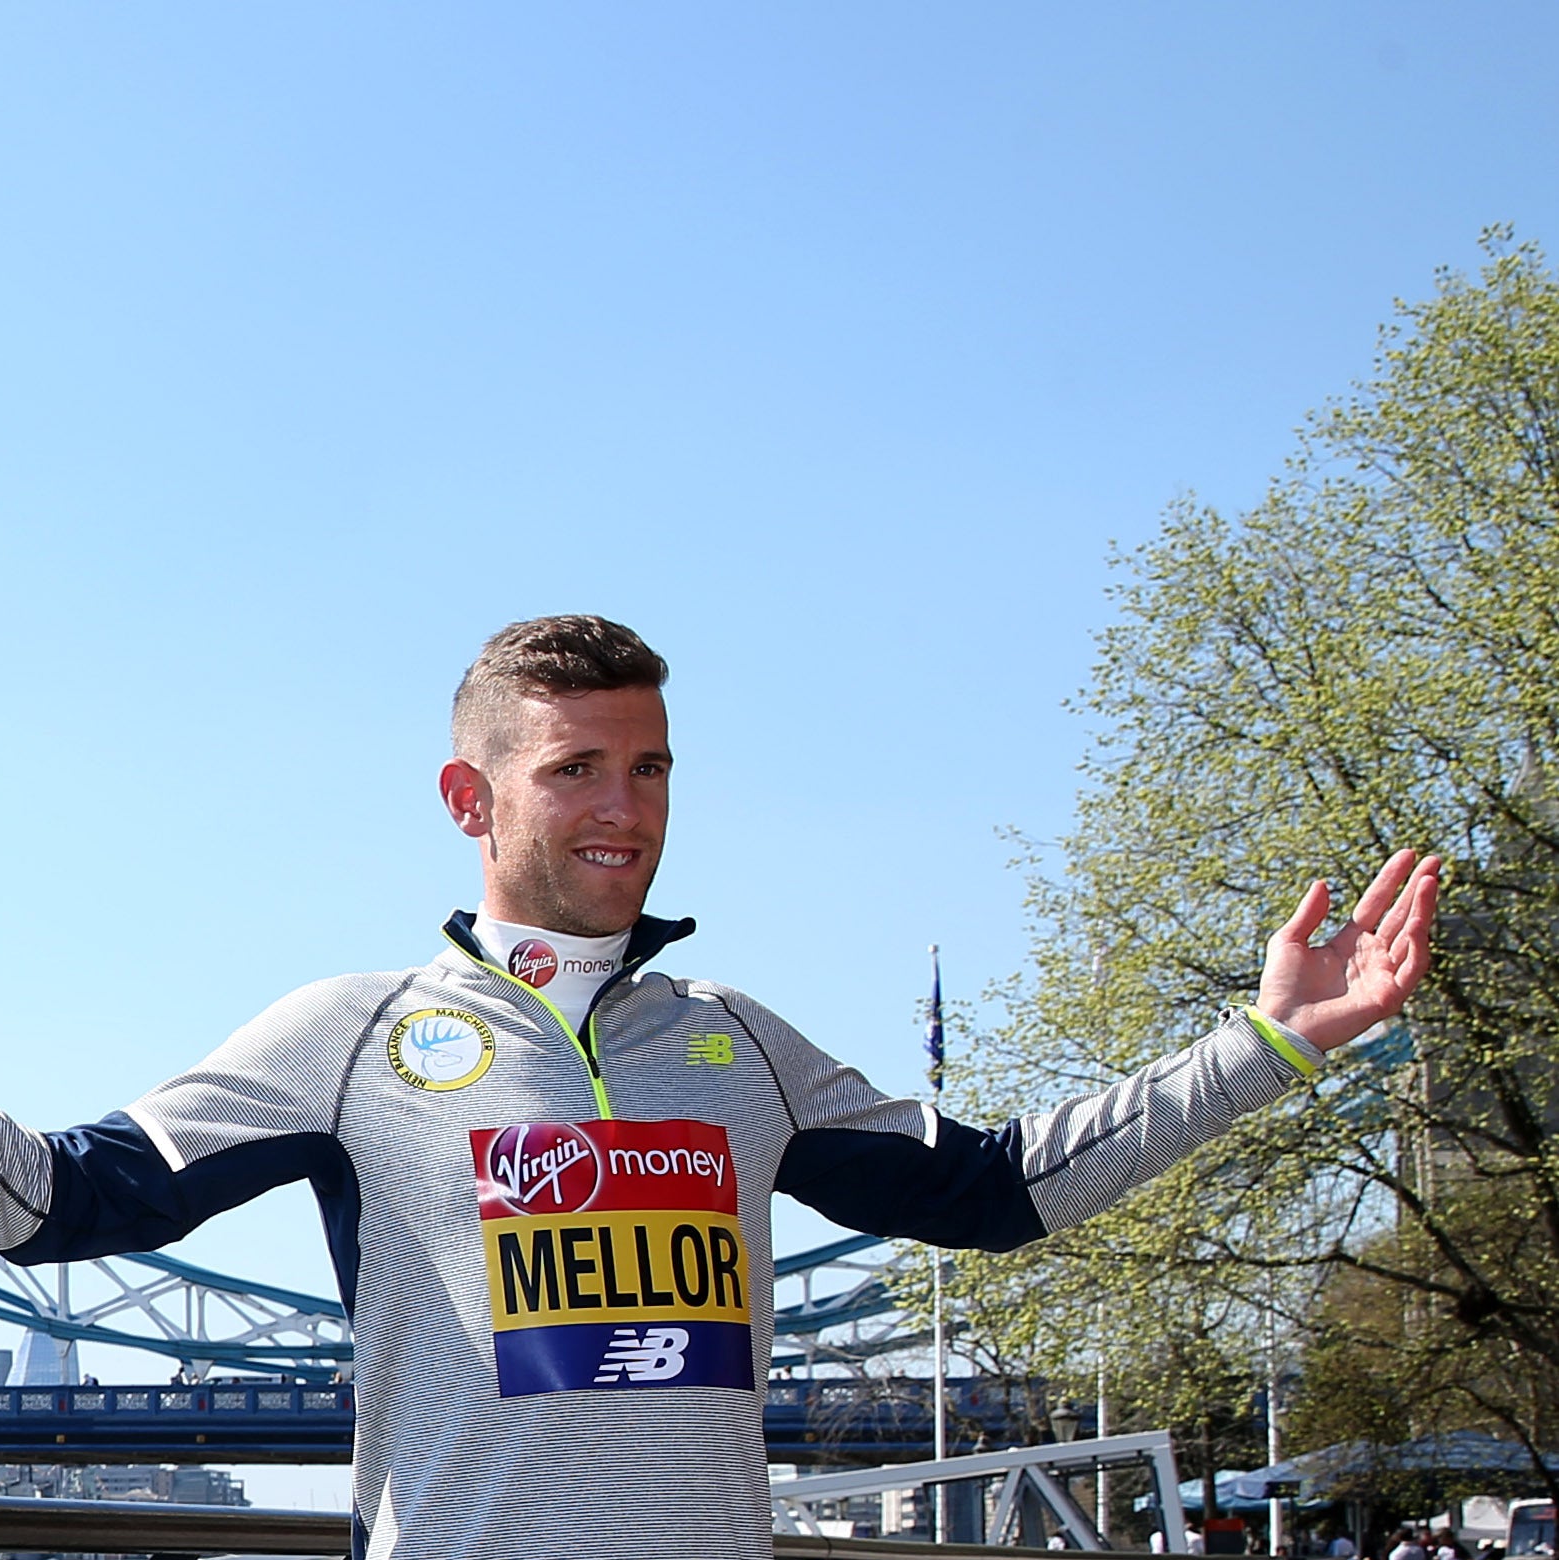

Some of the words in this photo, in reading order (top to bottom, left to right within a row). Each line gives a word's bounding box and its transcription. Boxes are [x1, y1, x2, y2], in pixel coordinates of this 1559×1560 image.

[512, 943, 555, 984] Virgin
[563, 959, 618, 974] money
[389, 1022, 409, 1070] BALANCE
[435, 1009, 493, 1051] MANCHESTER
[401, 1070, 427, 1089] NEW
[497, 1124, 590, 1204] Virgin
[609, 1149, 725, 1187] money
[498, 1224, 744, 1315] MELLOR
[593, 1327, 690, 1383] NB
